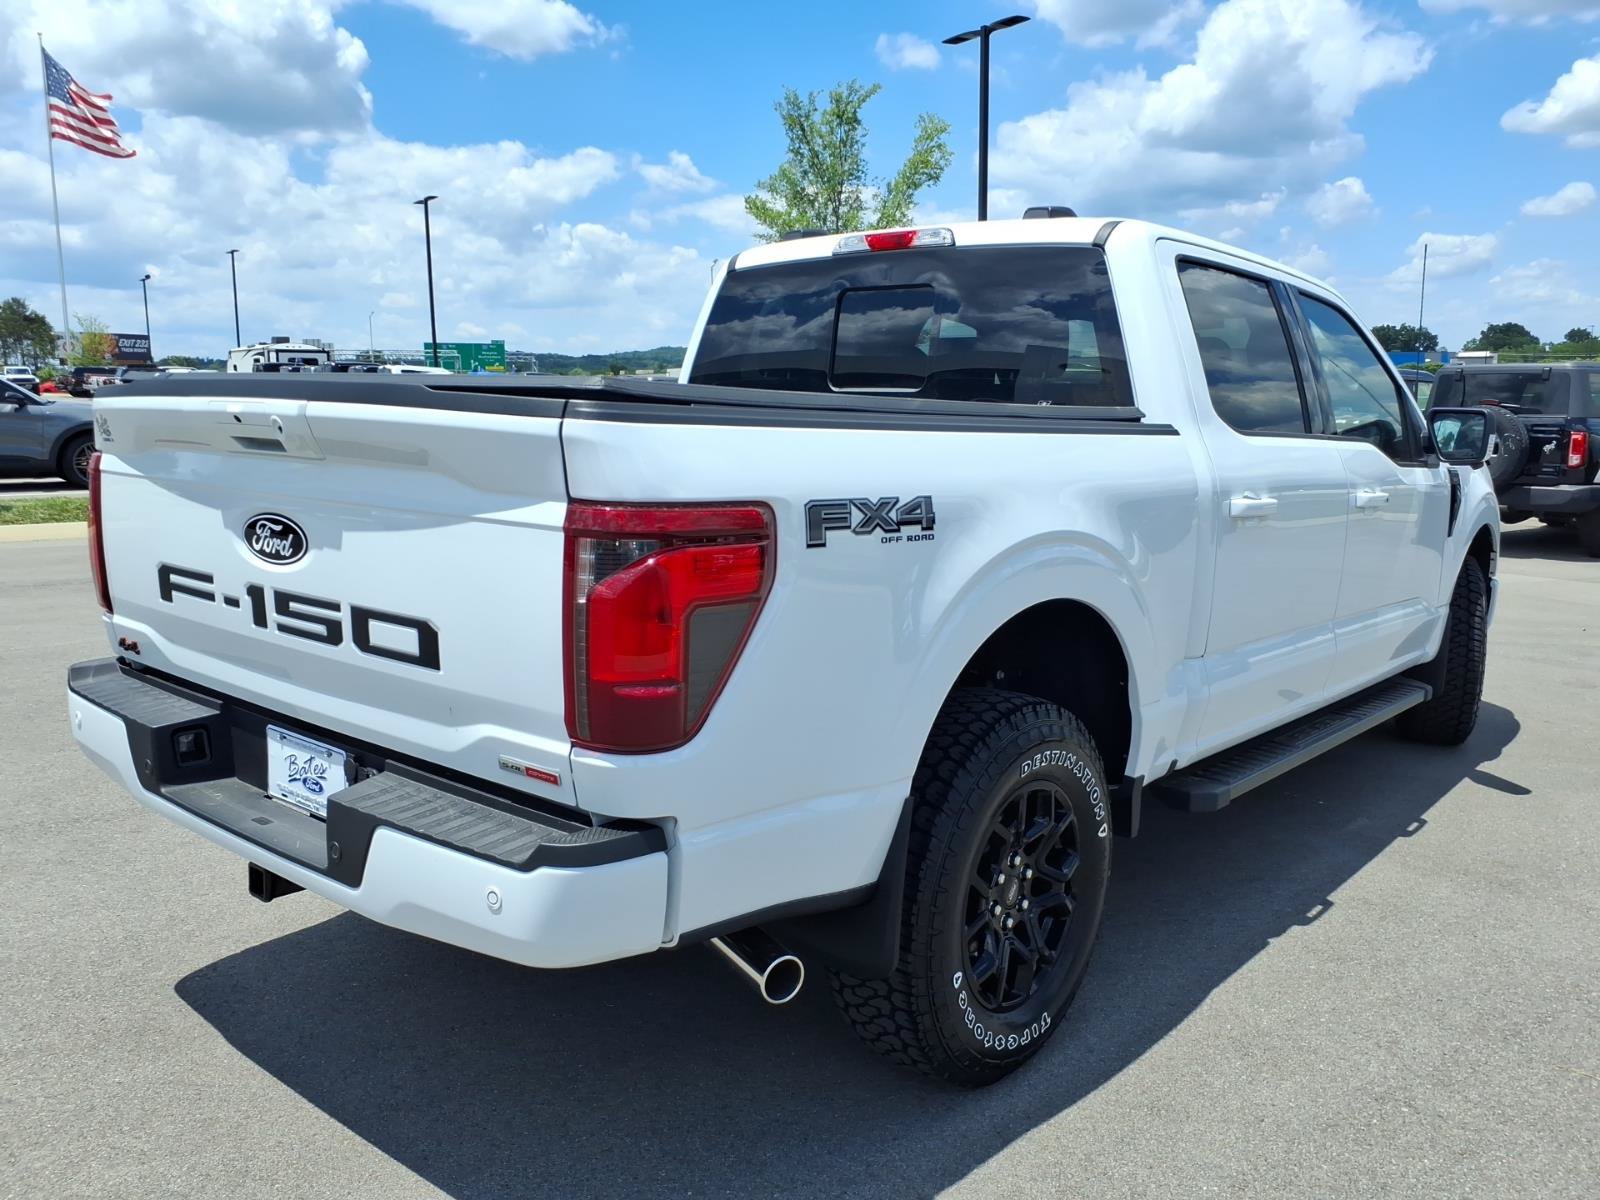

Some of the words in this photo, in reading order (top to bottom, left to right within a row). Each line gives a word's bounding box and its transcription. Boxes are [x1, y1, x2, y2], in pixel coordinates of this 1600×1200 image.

[251, 519, 294, 557] Ford
[804, 495, 936, 549] FX4
[880, 536, 903, 544] OFF
[906, 533, 935, 543] ROAD
[156, 561, 442, 673] F-150
[284, 754, 328, 778] Bates
[304, 777, 322, 793] Ford
[1021, 750, 1105, 821] DESTINATION
[958, 990, 1051, 1050] Firestone
